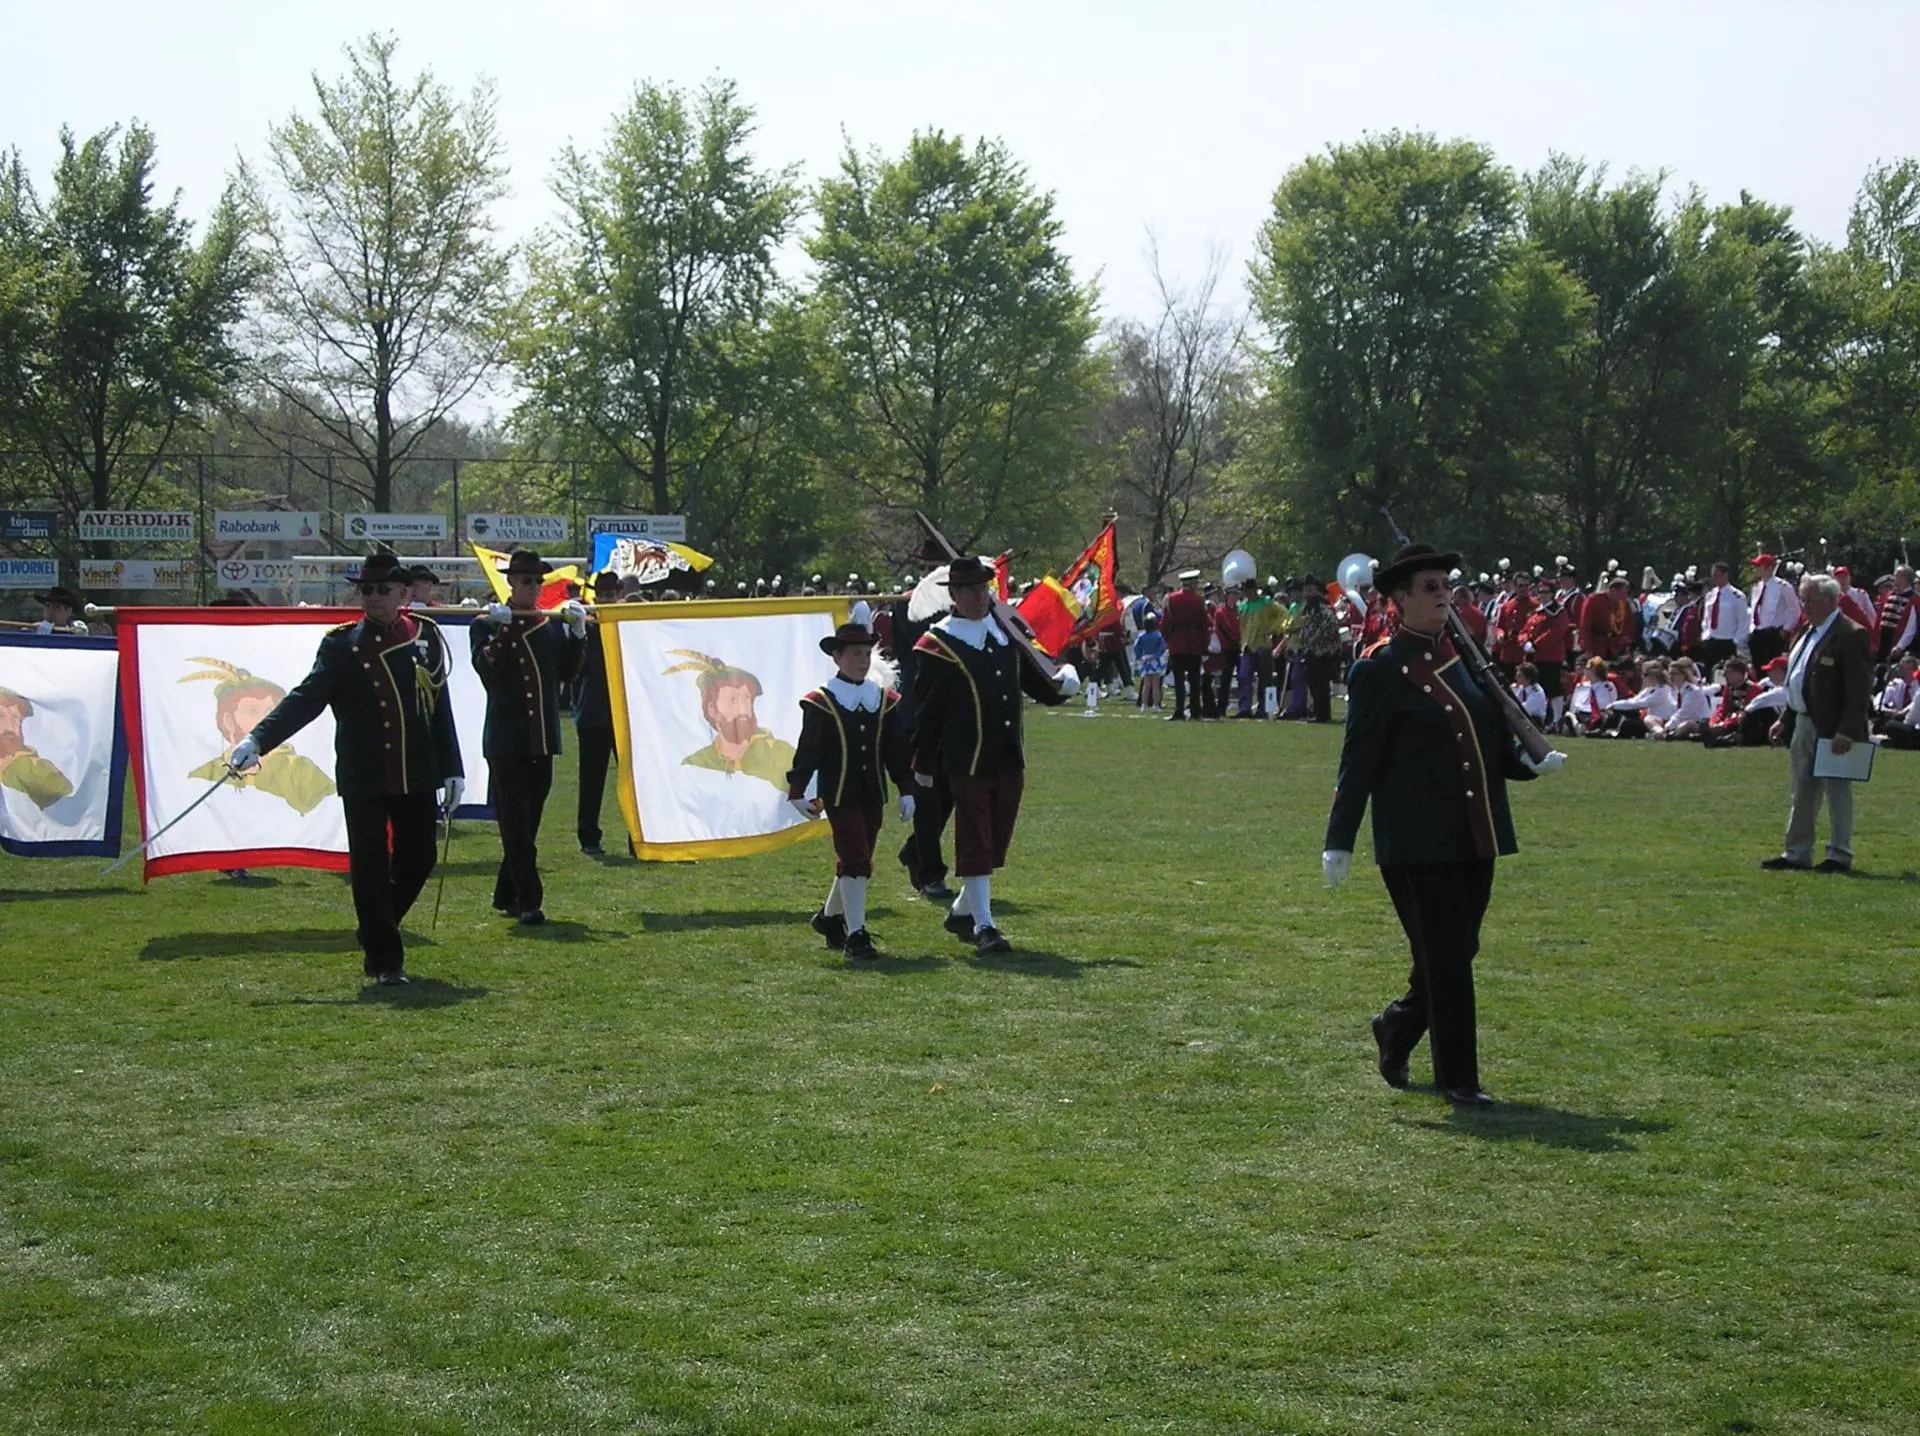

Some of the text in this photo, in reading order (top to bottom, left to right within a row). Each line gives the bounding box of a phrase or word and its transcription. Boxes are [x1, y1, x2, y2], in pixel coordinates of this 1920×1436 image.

[83, 513, 191, 526] AVERDIJK
[499, 517, 562, 528] HET WAPEN
[22, 527, 48, 537] dam
[82, 526, 191, 538] VERKEERSSCHOOL
[219, 519, 281, 533] Rabobank
[495, 528, 564, 539] VAN BECKUM
[10, 560, 56, 574] WORKEL
